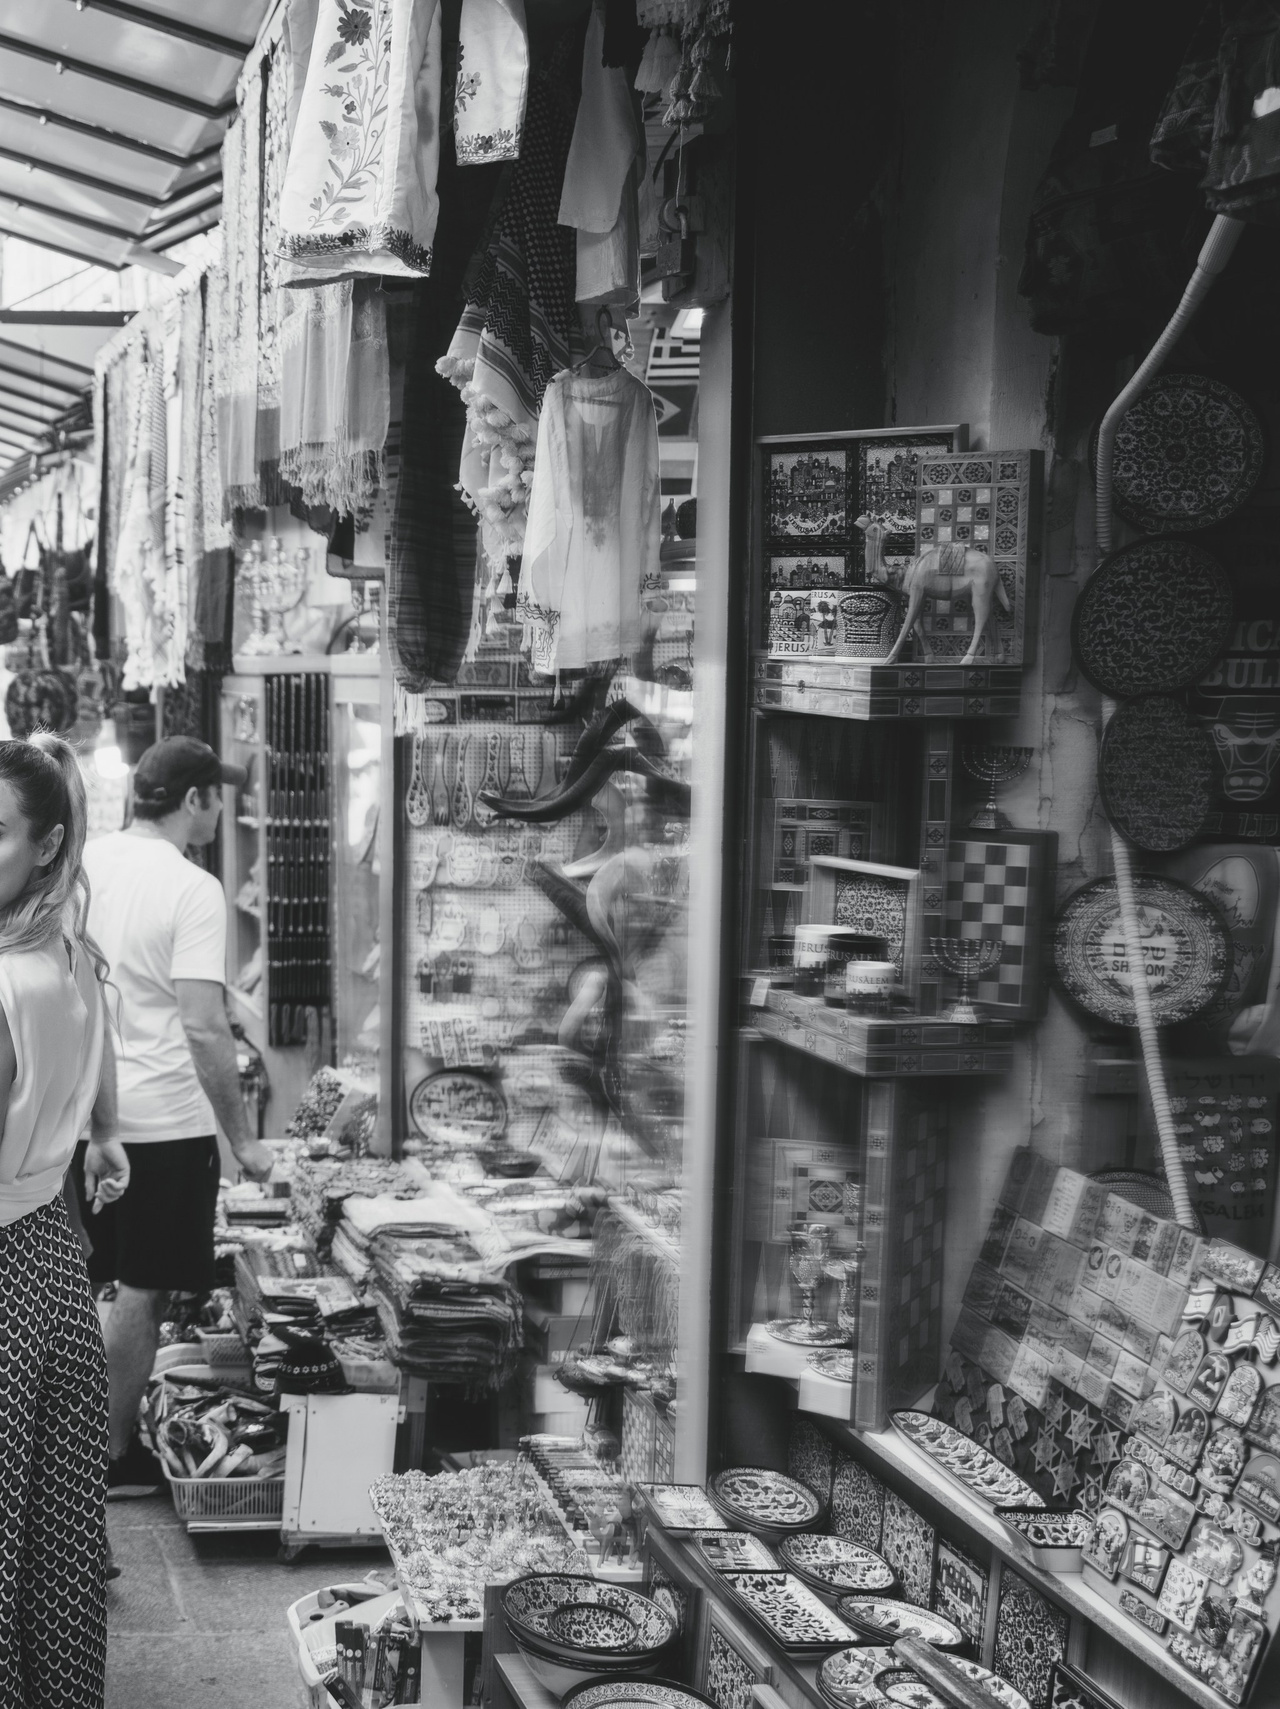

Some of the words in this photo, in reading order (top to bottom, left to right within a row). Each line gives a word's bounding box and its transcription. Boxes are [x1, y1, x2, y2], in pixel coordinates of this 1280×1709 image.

[1111, 960, 1165, 977] SHOM
[1191, 1388, 1212, 1408] ISRAEL
[1124, 1436, 1195, 1496] JERUSALEM
[1131, 1571, 1154, 1590] ISRAEL
[893, 1611, 937, 1632] Jerusalem
[892, 1685, 928, 1694] JERUS
